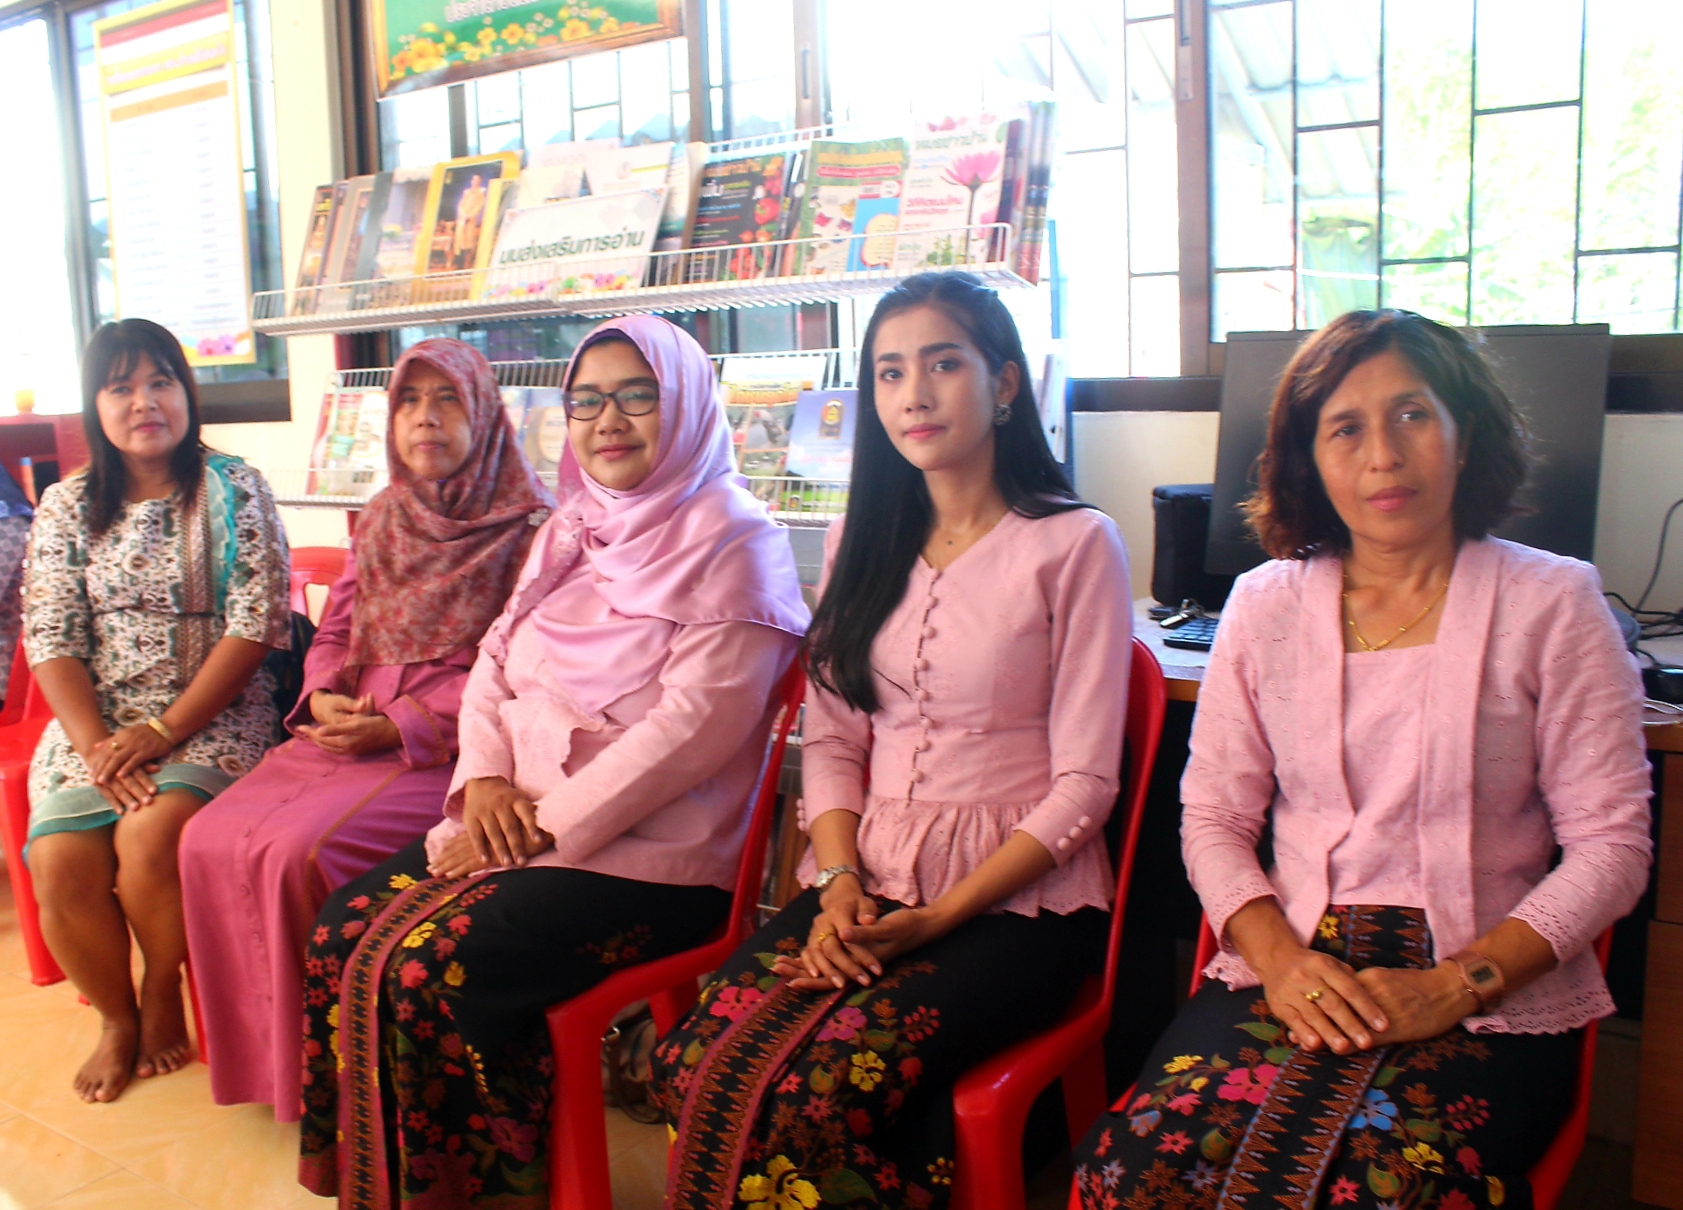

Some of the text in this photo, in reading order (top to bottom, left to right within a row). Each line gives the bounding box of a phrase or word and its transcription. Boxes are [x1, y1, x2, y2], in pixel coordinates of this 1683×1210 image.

[499, 226, 645, 264] มมส่งเสริมการอ่าน
